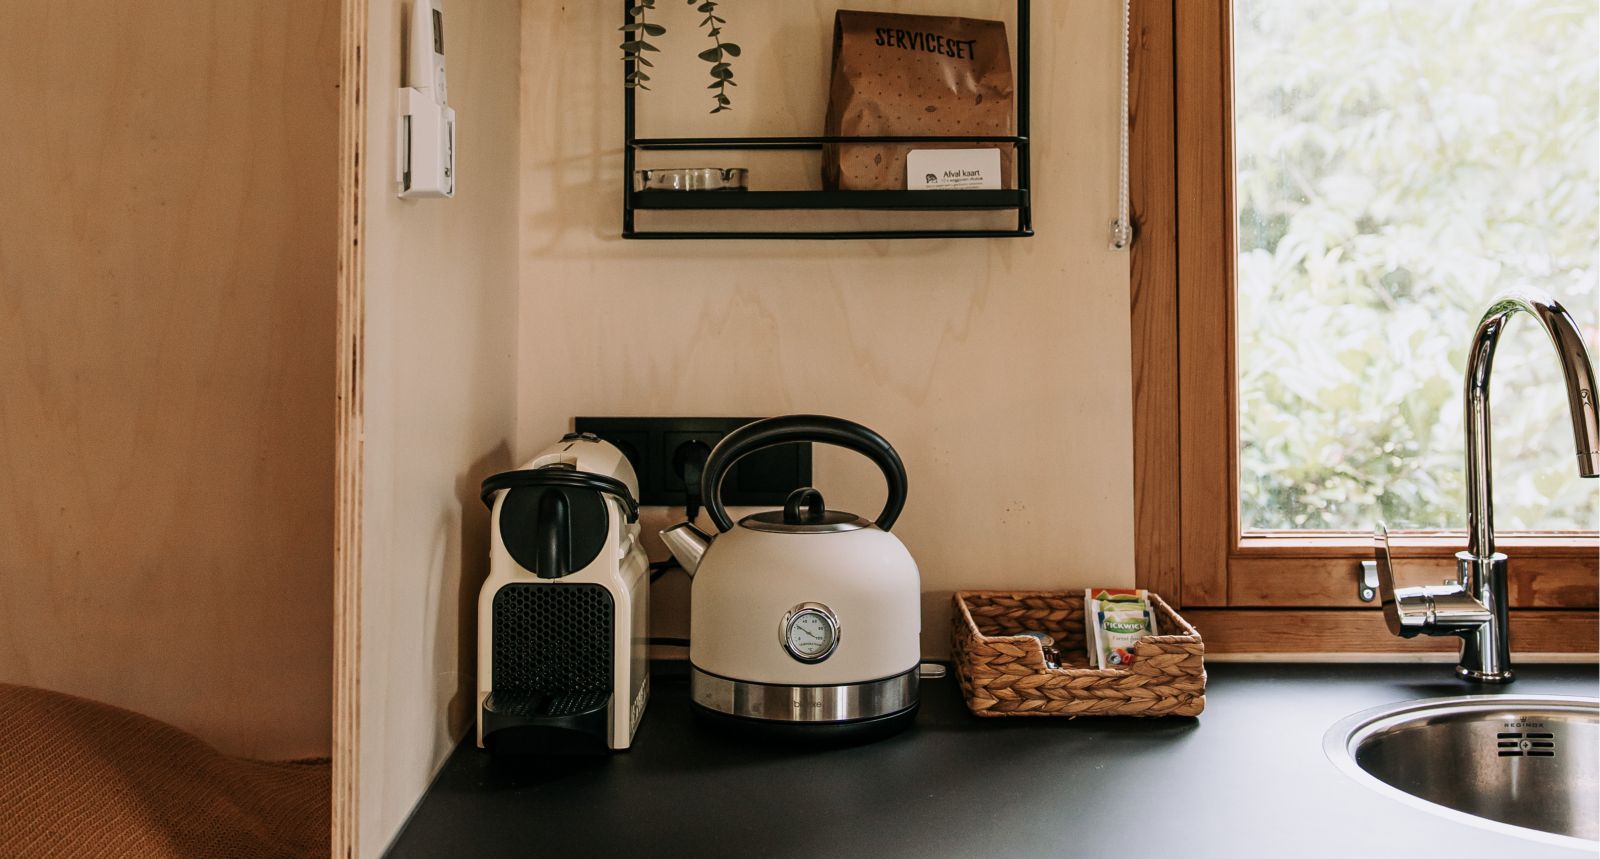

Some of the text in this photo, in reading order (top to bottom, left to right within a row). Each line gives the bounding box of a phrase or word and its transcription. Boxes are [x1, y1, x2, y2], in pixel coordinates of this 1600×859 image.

[875, 27, 976, 60] SERVICESET
[962, 169, 980, 177] kaart
[1103, 621, 1145, 630] PICKWICK
